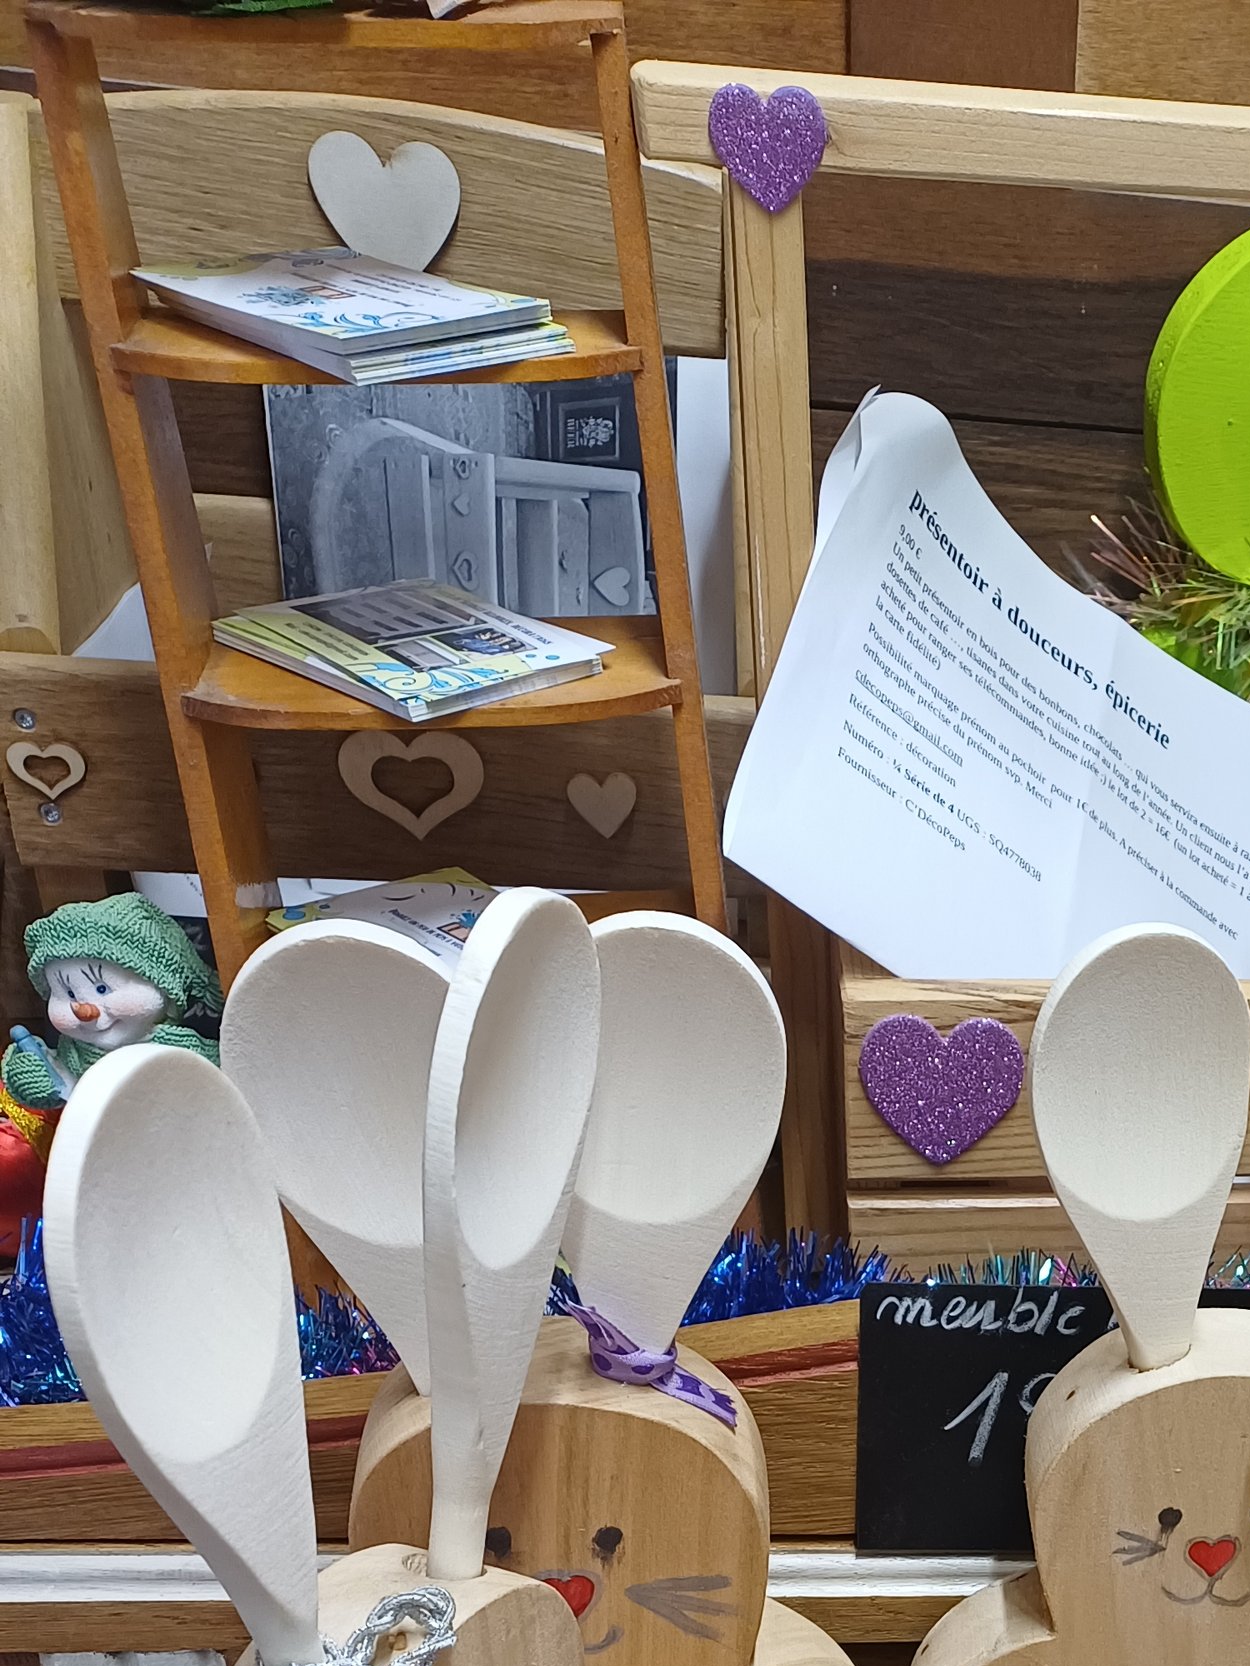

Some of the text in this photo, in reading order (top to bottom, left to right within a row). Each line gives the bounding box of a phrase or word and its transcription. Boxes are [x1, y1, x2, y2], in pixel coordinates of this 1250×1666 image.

[898, 524, 916, 551] 9,00
[908, 488, 1170, 750] présentoir à douceurs, épicerie
[875, 595, 942, 671] la carte fidélité)
[892, 542, 905, 563] Un
[904, 560, 923, 585] petit
[922, 582, 965, 629] présentoir
[966, 626, 978, 642] en
[979, 635, 998, 660] bois
[999, 657, 1021, 680] pour
[1021, 676, 1037, 695] des
[1039, 689, 1081, 728] bonbons,
[1083, 724, 1123, 761] chocolats
[1135, 767, 1149, 785] qui
[1150, 781, 1169, 802] vous
[1170, 798, 1198, 826] servira
[1199, 822, 1232, 849] ensuite
[837, 746, 898, 799] Fournisseur
[849, 693, 898, 740] Référence
[905, 742, 956, 788] décoration
[855, 669, 964, 767] cdecopeps@gmail.com
[863, 643, 916, 697] orthographe
[917, 694, 951, 727] précise
[952, 722, 965, 740] du
[966, 736, 1003, 770] prénom
[1025, 781, 1053, 809] Merci
[868, 621, 913, 672] Possibilité
[913, 670, 960, 714] marquage
[960, 710, 997, 745] prénom
[998, 742, 1010, 757] au
[1011, 752, 1047, 785] pochoir
[1050, 783, 1073, 804] pour
[1076, 798, 1089, 814] 1€
[1088, 809, 1099, 823] de
[1099, 820, 1118, 842] plus.
[1127, 844, 1159, 877] préciser
[1175, 886, 1218, 925] commande
[1218, 921, 1239, 941] avec
[880, 580, 906, 613] acheté
[906, 610, 928, 634] pour
[928, 630, 957, 663] ranger
[959, 660, 973, 678] ses
[974, 673, 1046, 741] télécommandes,
[1048, 734, 1078, 762] bonne
[1080, 756, 1100, 776] idée
[1117, 787, 1128, 805] lot
[1129, 801, 1139, 815] de
[1173, 838, 1188, 856] (un
[1189, 850, 1201, 866] lot
[1201, 863, 1229, 886] acheté
[886, 562, 917, 603] dosettes
[917, 600, 929, 616] de
[930, 613, 950, 635] café
[966, 646, 997, 679] tisanes
[998, 676, 1023, 699] dans
[1021, 696, 1045, 718] votre
[1046, 716, 1080, 745] cuisine
[1082, 740, 1101, 759] tout
[1101, 757, 1112, 769] au
[1112, 764, 1130, 789] long
[1131, 783, 1142, 797] de
[1175, 820, 1188, 837] Un
[1189, 833, 1213, 856] client
[1214, 851, 1235, 871] nous
[843, 719, 884, 759] Numéro
[904, 767, 931, 796] Série
[933, 790, 946, 807] de
[956, 809, 981, 834] UGS
[988, 833, 1042, 882] SQ4778038
[876, 1287, 1086, 1337] meuble
